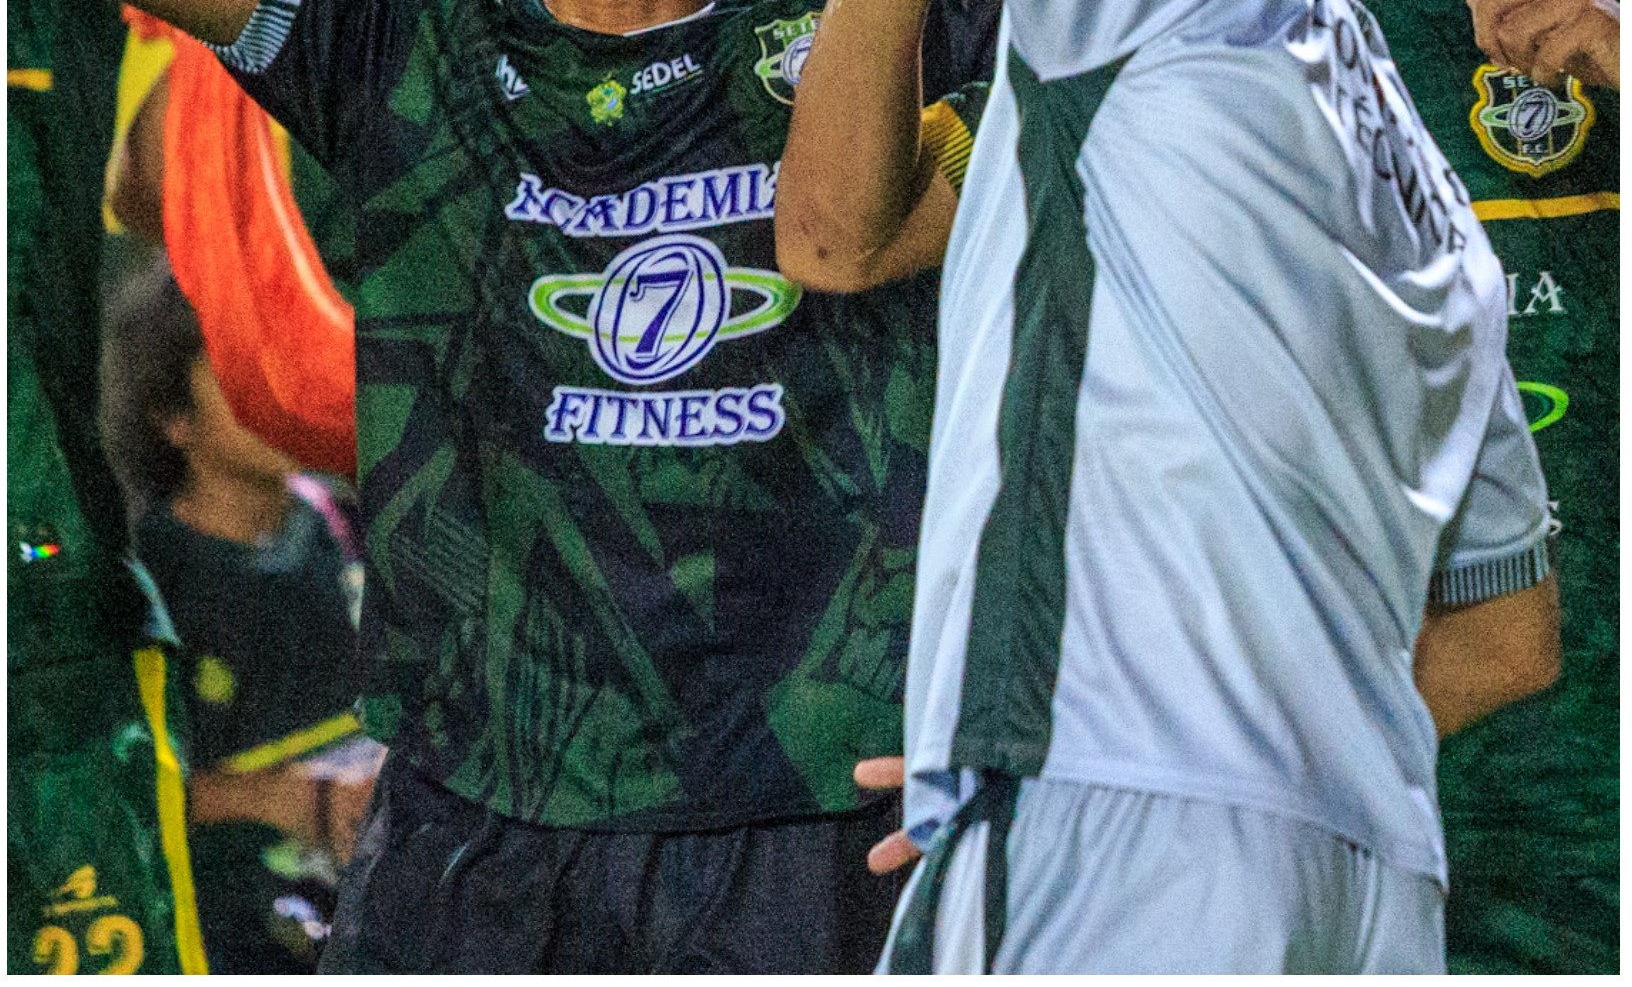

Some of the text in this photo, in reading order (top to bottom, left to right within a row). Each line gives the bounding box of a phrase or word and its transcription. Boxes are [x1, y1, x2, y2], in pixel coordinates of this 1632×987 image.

[630, 54, 701, 95] SEDEL
[1521, 99, 1546, 131] 7
[629, 269, 695, 360] 7
[549, 388, 782, 439] FITNESS
